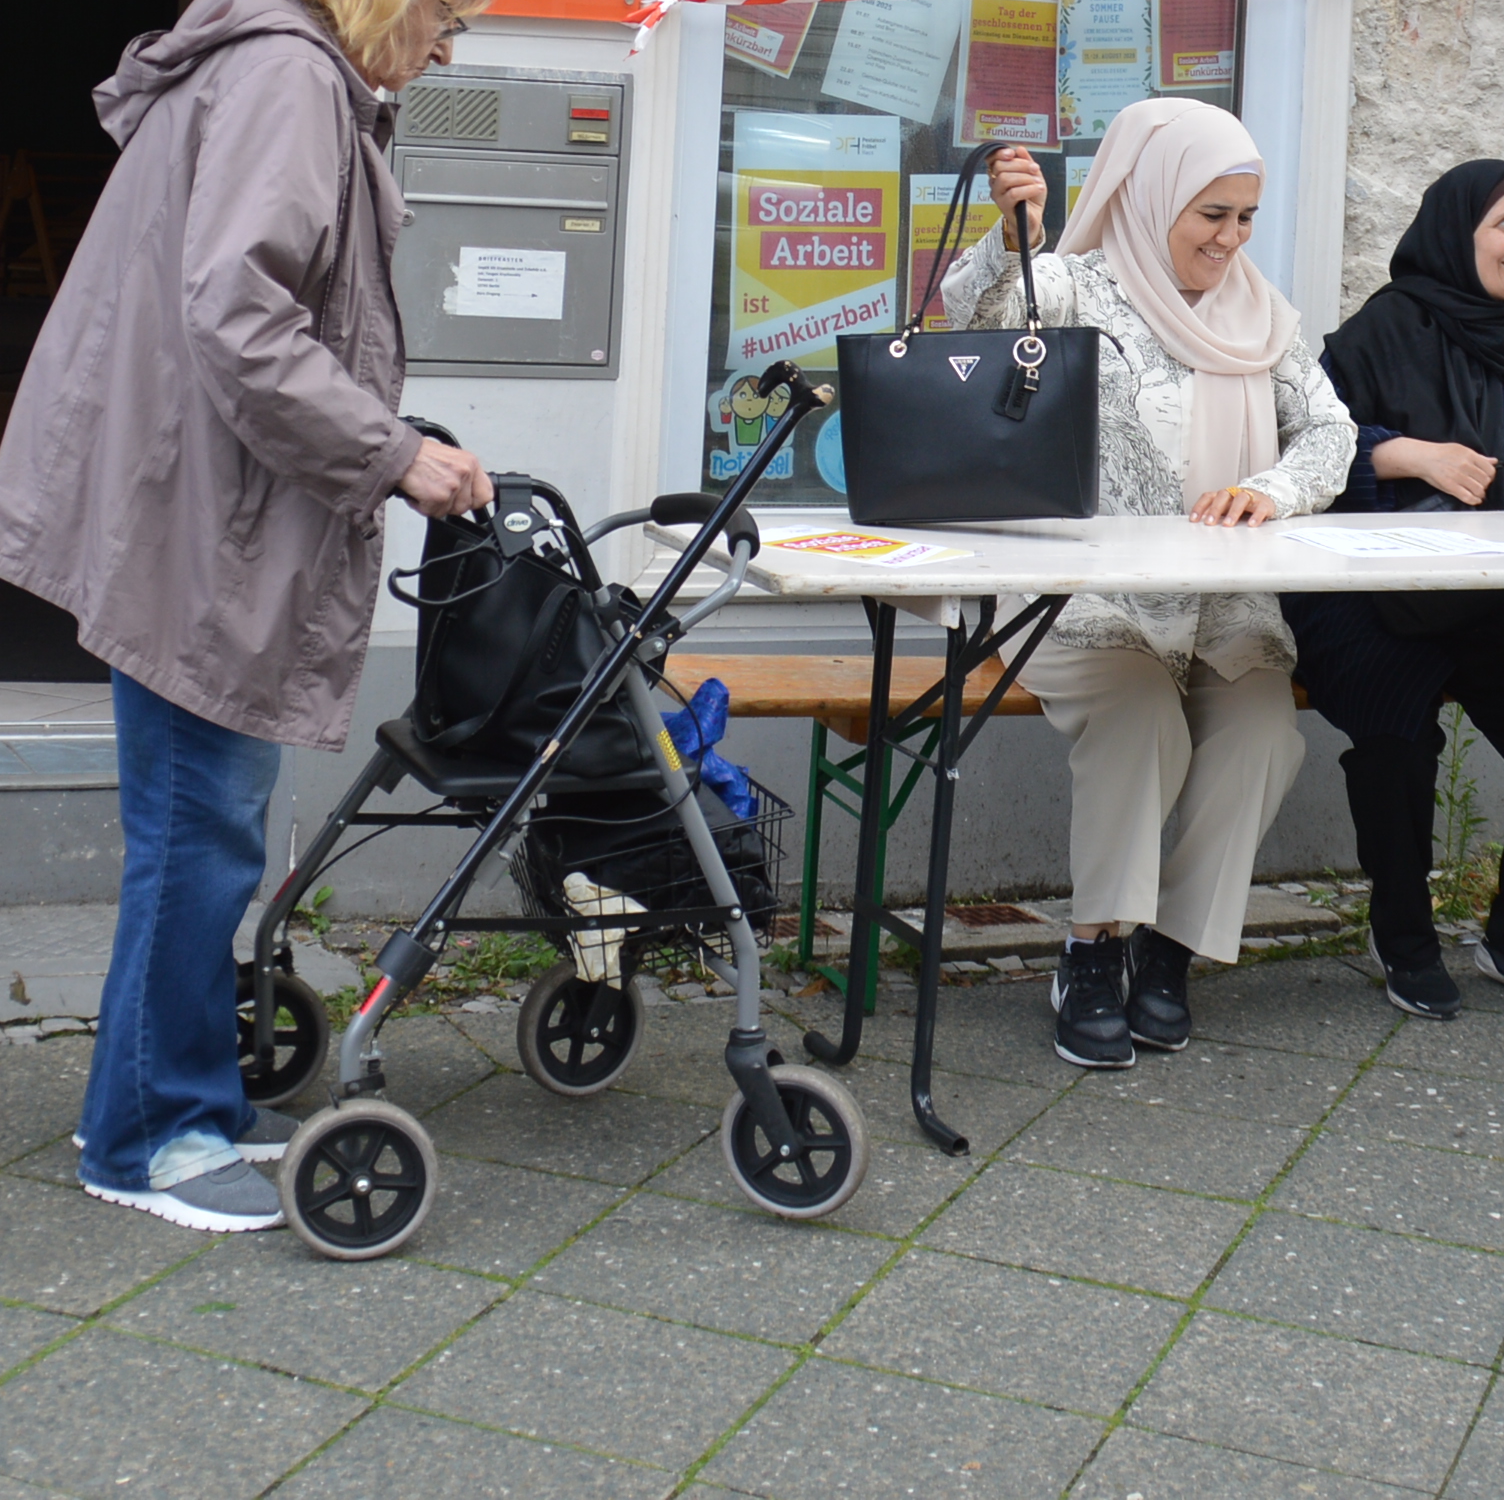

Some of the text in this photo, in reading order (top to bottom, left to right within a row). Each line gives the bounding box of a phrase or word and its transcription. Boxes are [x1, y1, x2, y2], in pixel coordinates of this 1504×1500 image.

[876, 0, 893, 11] 2025
[1089, 3, 1124, 12] SOMMER
[998, 6, 1037, 19] Tag der
[1093, 14, 1120, 24] PAUSE
[973, 17, 1056, 33] geschlossenen Tü
[725, 32, 773, 57] nkürzbar!
[1185, 66, 1232, 77] #unkürzbar
[980, 114, 1025, 125] Soziale Arbeit
[985, 126, 1043, 139] #unkürzbar!
[759, 191, 873, 223] Soziale
[770, 236, 874, 266] Arbeit
[743, 293, 770, 314] ist
[742, 292, 890, 359] #unkürzbar!
[930, 320, 953, 328] Sozial
[712, 451, 790, 476] notsel
